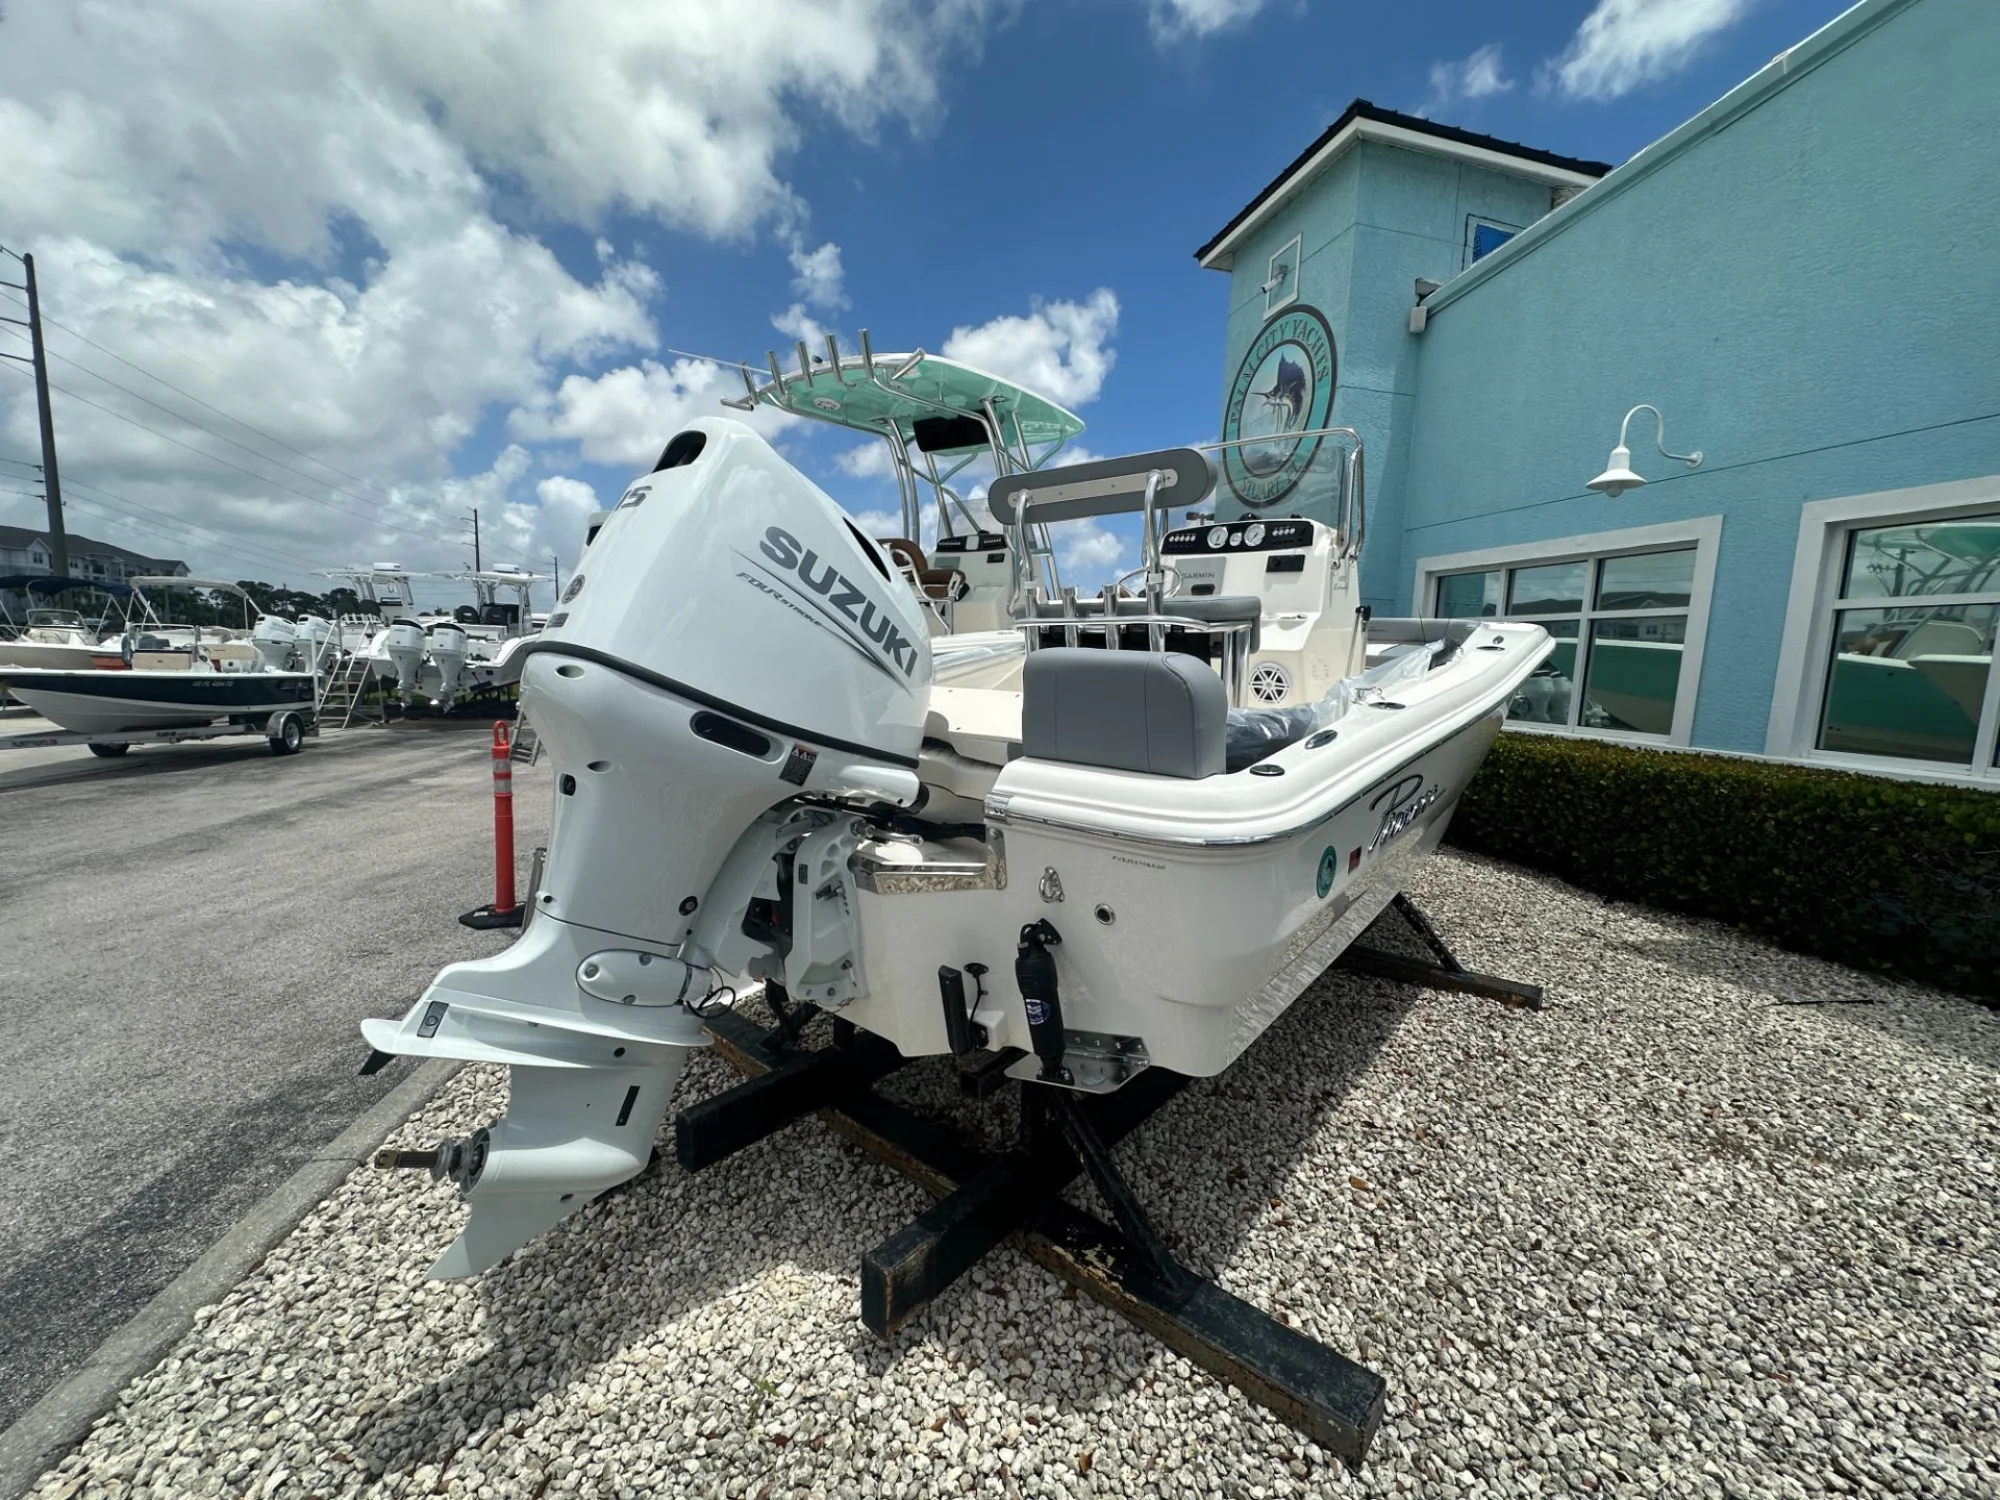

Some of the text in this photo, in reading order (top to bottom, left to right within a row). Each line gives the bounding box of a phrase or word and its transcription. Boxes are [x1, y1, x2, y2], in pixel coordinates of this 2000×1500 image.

[1256, 321, 1289, 361] CITY
[1292, 318, 1329, 383] YACHTS
[759, 526, 918, 678] SUZUKI
